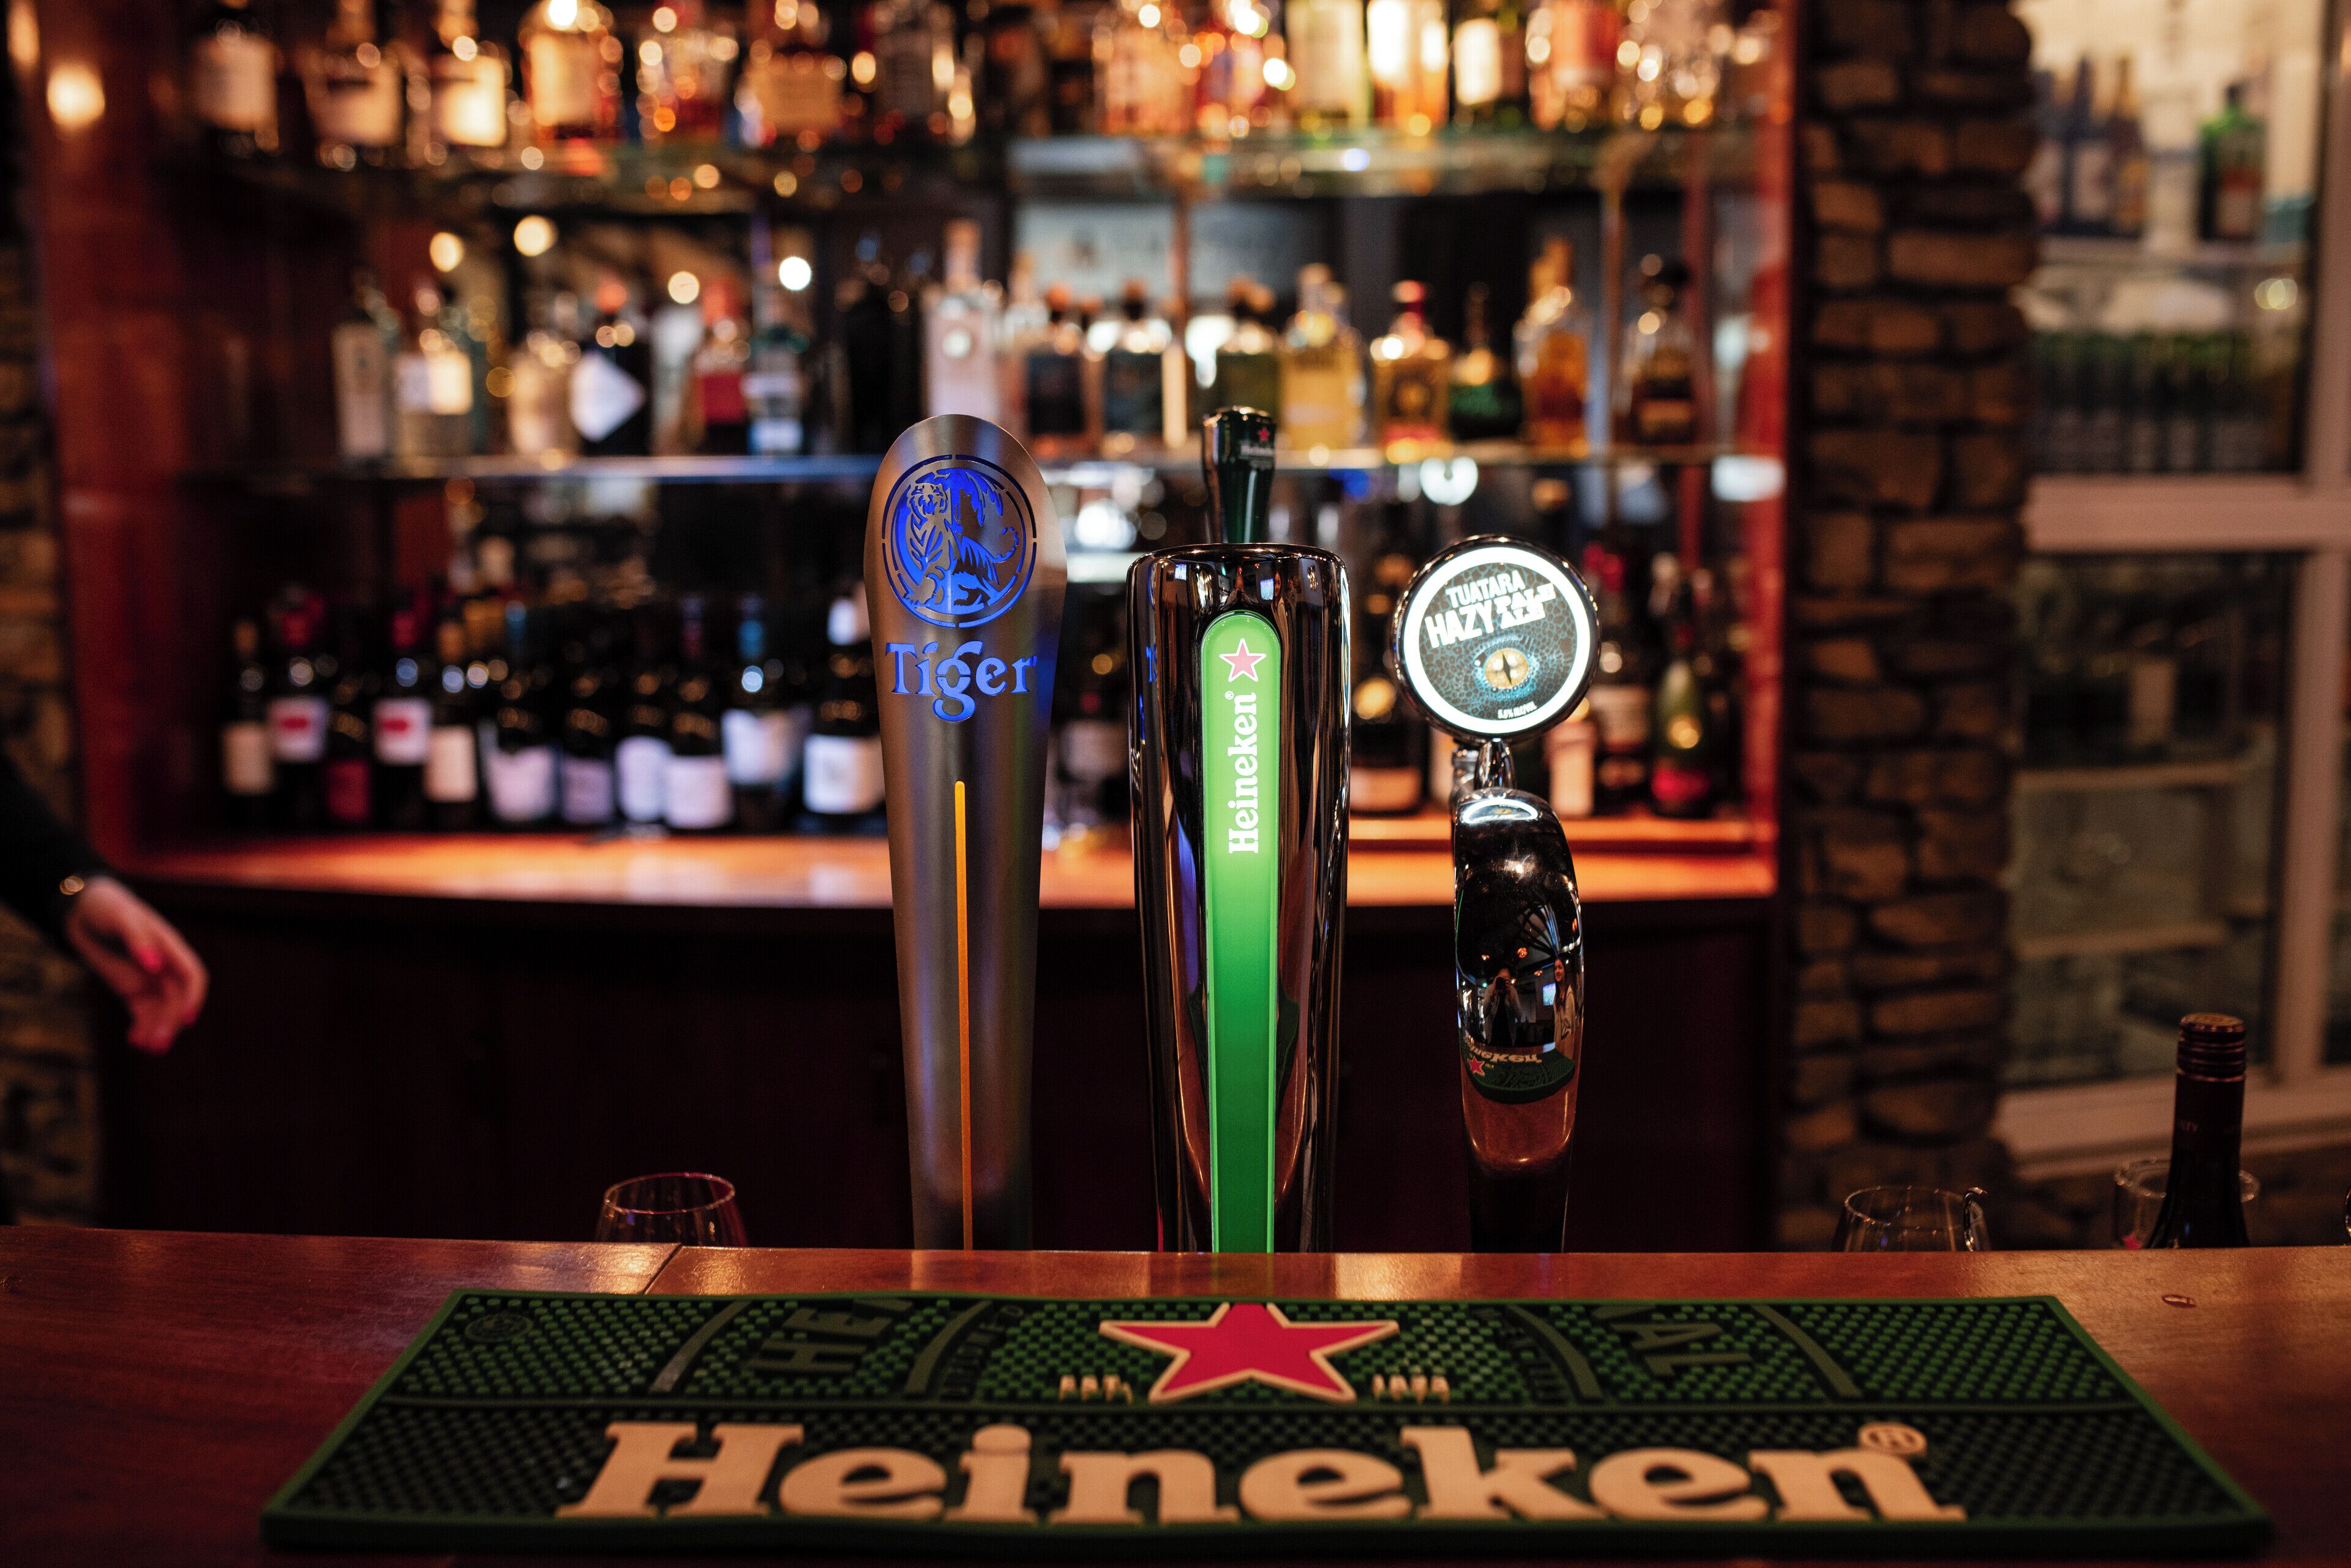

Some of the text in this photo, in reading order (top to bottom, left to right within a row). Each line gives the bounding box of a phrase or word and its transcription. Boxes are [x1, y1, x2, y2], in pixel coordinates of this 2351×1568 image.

[1445, 569, 1526, 609] TUATARA
[1493, 582, 1556, 614] PALE
[1425, 599, 1494, 648] HAZY
[1501, 602, 1546, 629] ALE
[886, 640, 1038, 722] Tiger
